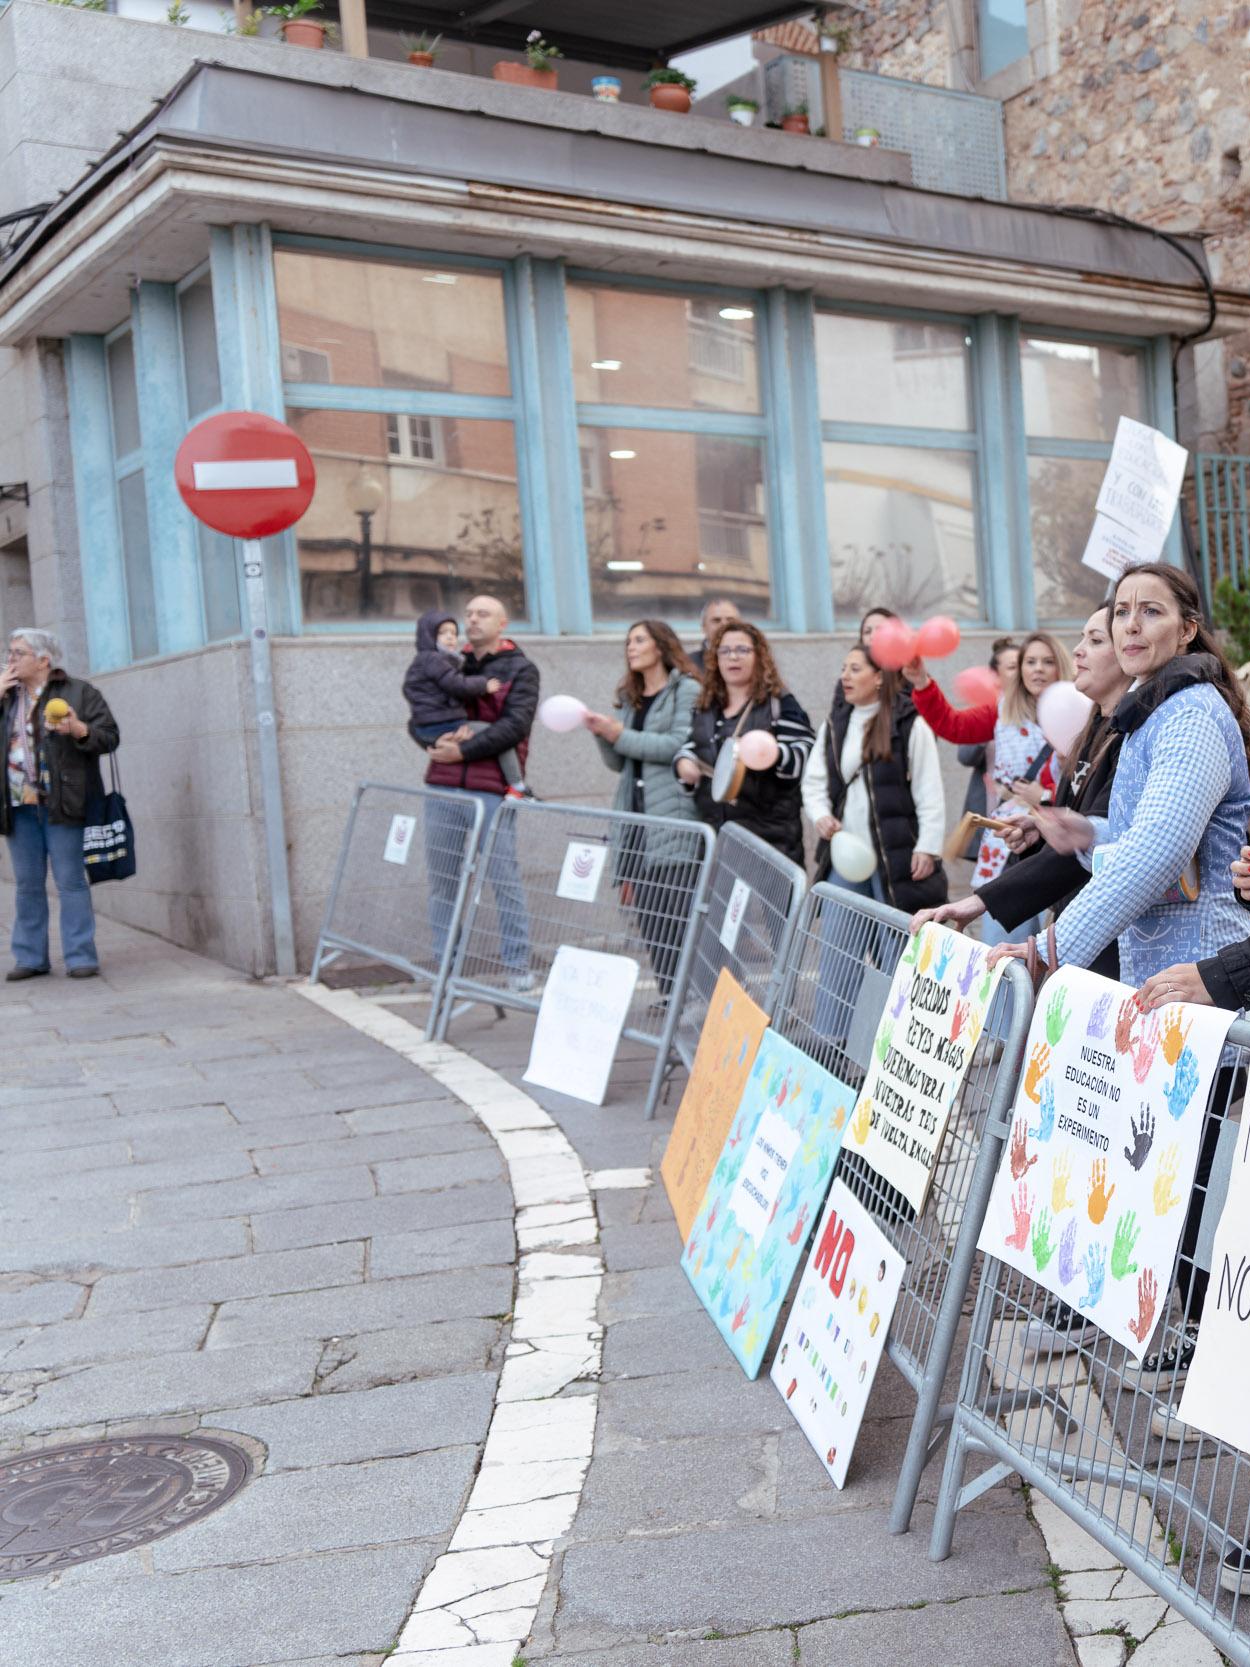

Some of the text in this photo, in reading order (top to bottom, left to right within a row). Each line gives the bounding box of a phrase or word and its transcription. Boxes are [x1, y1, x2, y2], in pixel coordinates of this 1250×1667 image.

[907, 1015, 965, 1072] REYES MAGOS
[1080, 1045, 1116, 1073] NUESTRA
[882, 1043, 922, 1088] QUEREMOS
[1065, 1065, 1121, 1103] EDUCACIÓN NO
[869, 1108, 881, 1130] DE
[1077, 1096, 1100, 1120] ES UN
[1058, 1114, 1110, 1152] EXPERIMENTO
[813, 1209, 855, 1298] NO
